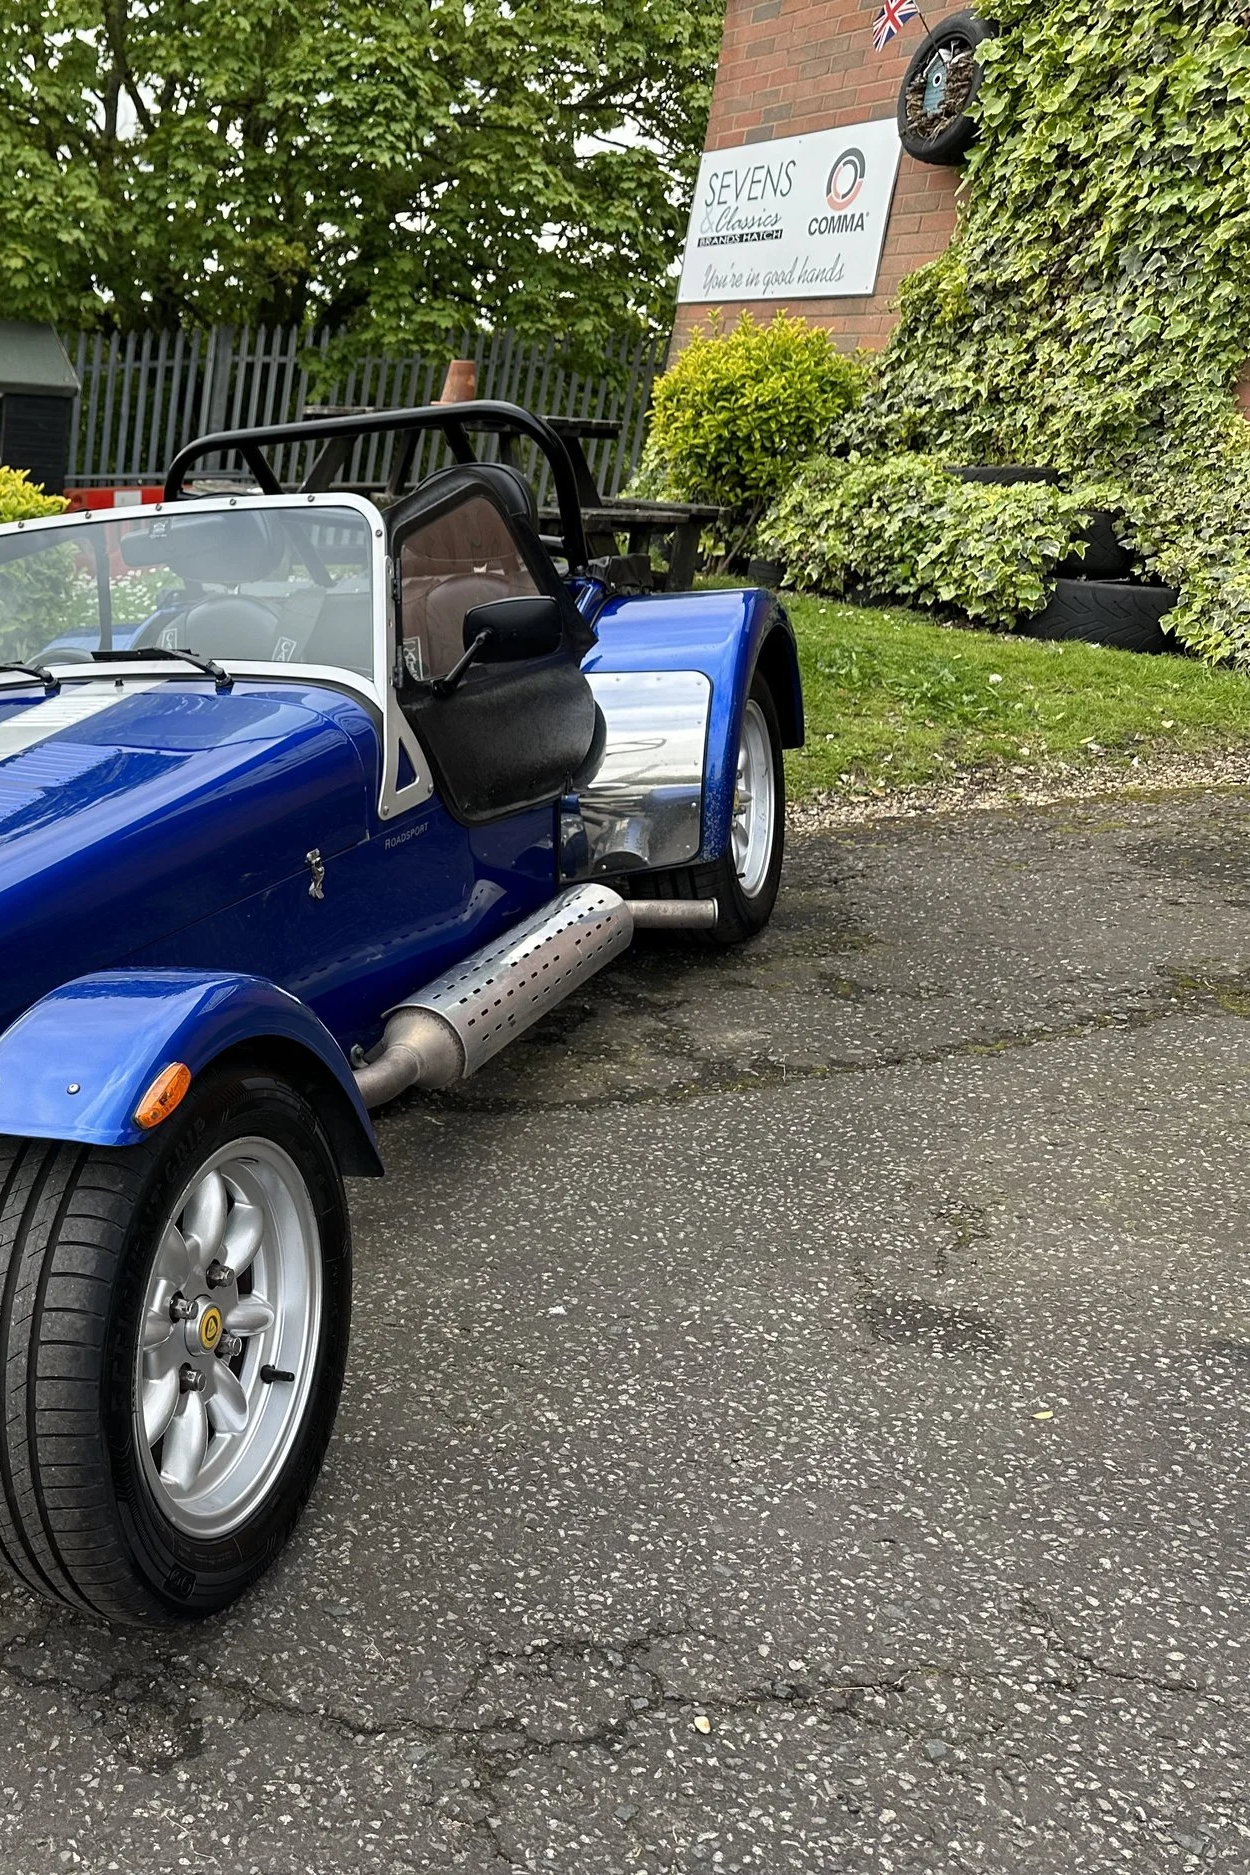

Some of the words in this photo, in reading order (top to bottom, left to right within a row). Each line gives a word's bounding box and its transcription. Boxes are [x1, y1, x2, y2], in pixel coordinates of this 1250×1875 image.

[704, 159, 797, 207] SEVENS
[700, 205, 715, 234] &
[715, 206, 782, 233] Classics
[699, 234, 741, 247] BRANDS
[742, 229, 783, 242] HATCH
[702, 262, 743, 297] You're
[745, 267, 760, 288] in
[762, 256, 798, 296] good
[797, 252, 845, 284] hands
[384, 821, 430, 850] ROADSPORT
